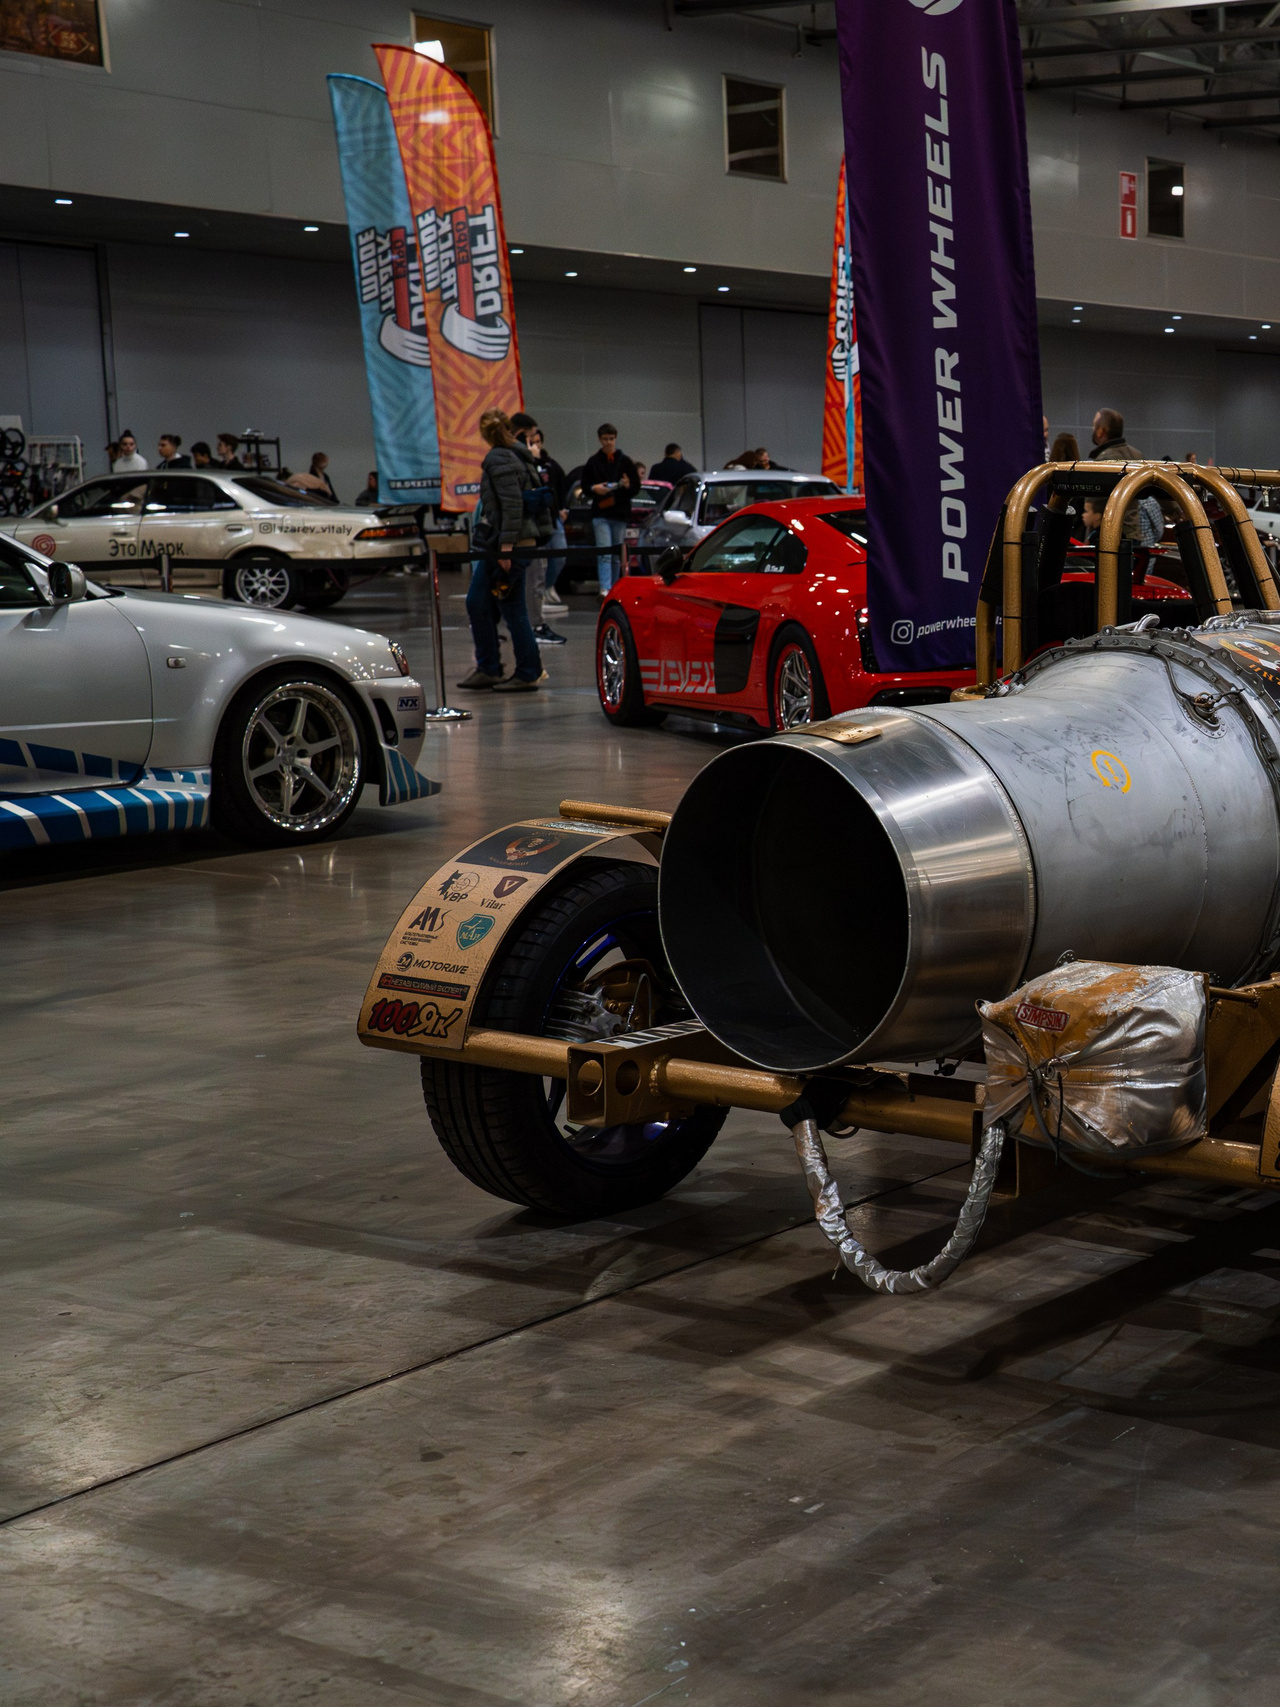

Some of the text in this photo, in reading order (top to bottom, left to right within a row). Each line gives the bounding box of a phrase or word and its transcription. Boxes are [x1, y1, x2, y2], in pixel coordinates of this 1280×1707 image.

[921, 46, 970, 583] POWER WHEELS
[108, 539, 137, 557] Это
[399, 698, 419, 708] NX
[480, 898, 506, 910] Vilar
[413, 959, 469, 974] MOTORAVE
[1020, 1007, 1063, 1028] SIMPSON
